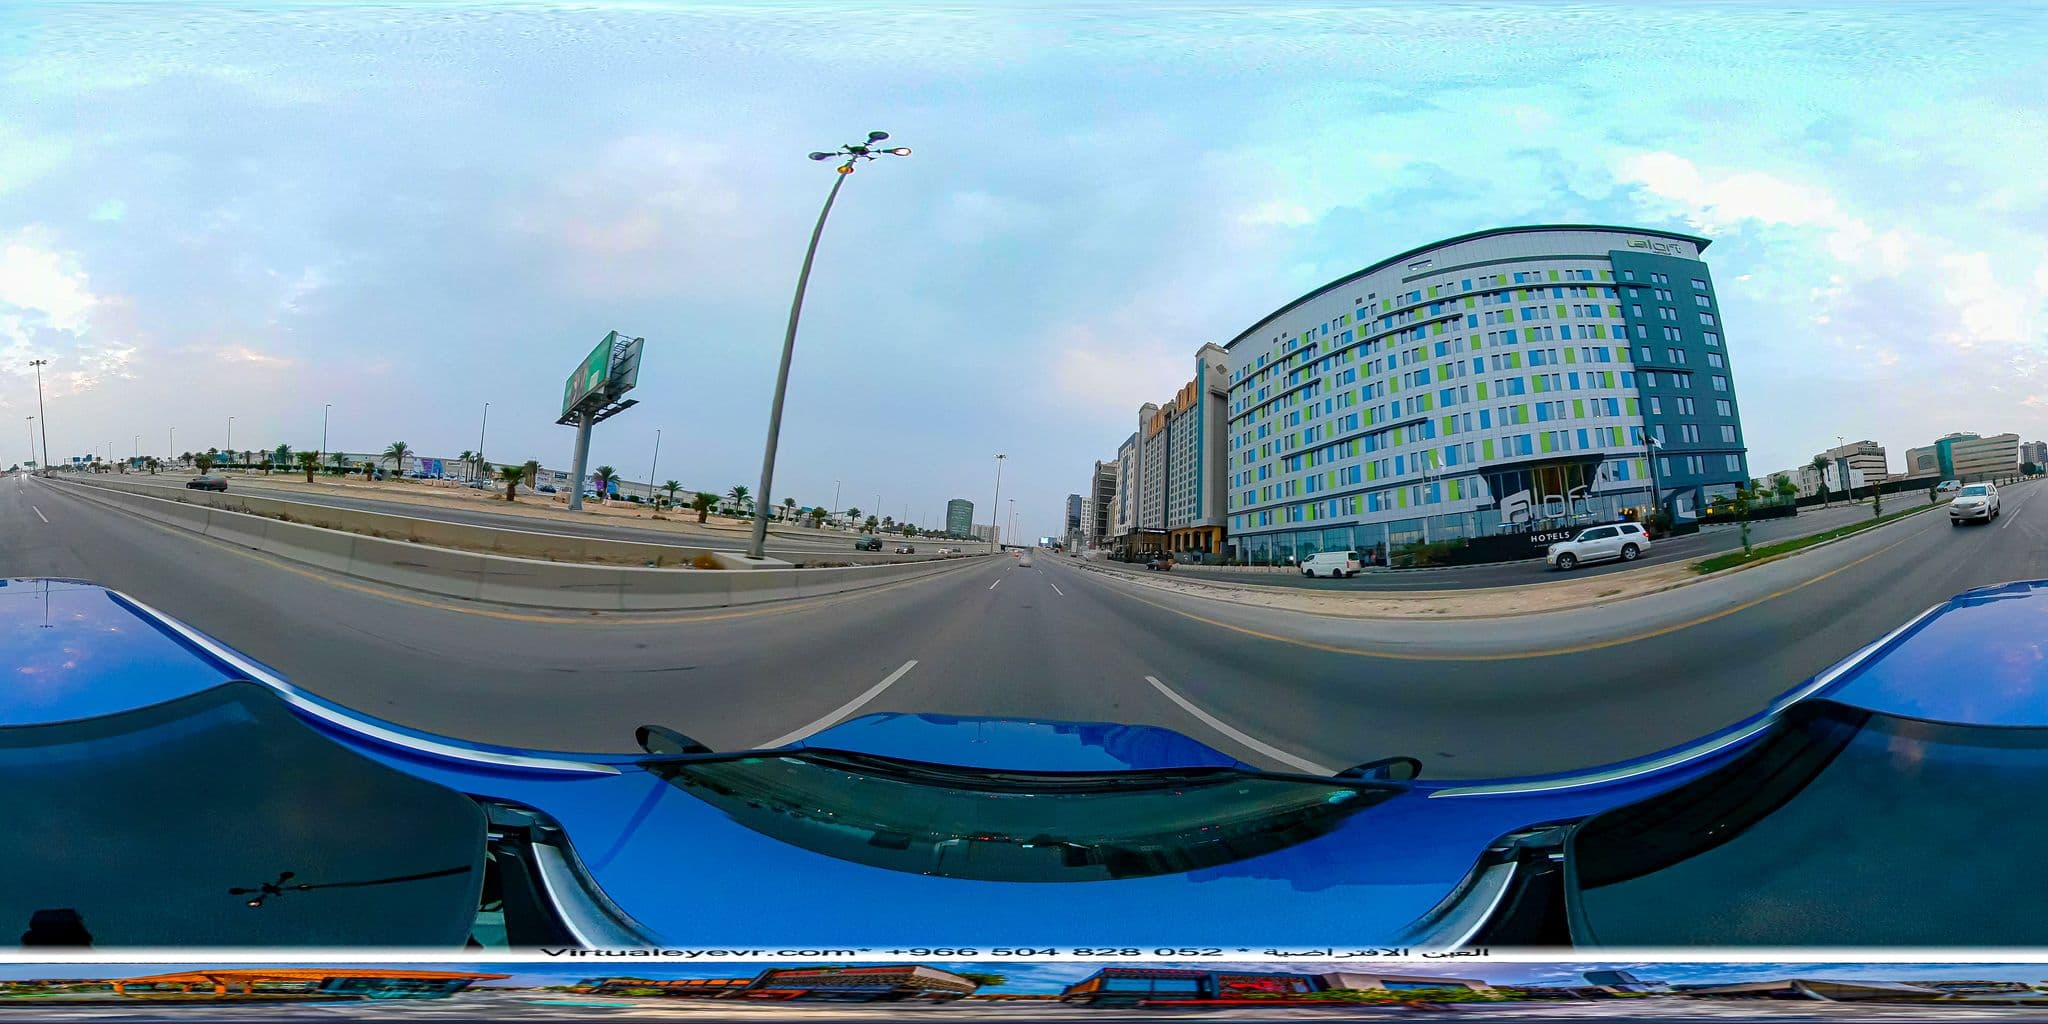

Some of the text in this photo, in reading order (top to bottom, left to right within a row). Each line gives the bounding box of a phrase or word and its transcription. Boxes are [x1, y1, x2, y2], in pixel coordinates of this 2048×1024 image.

[1626, 239, 1681, 254] aloft
[1500, 485, 1596, 523] aloft
[1530, 531, 1570, 543] HOTELS
